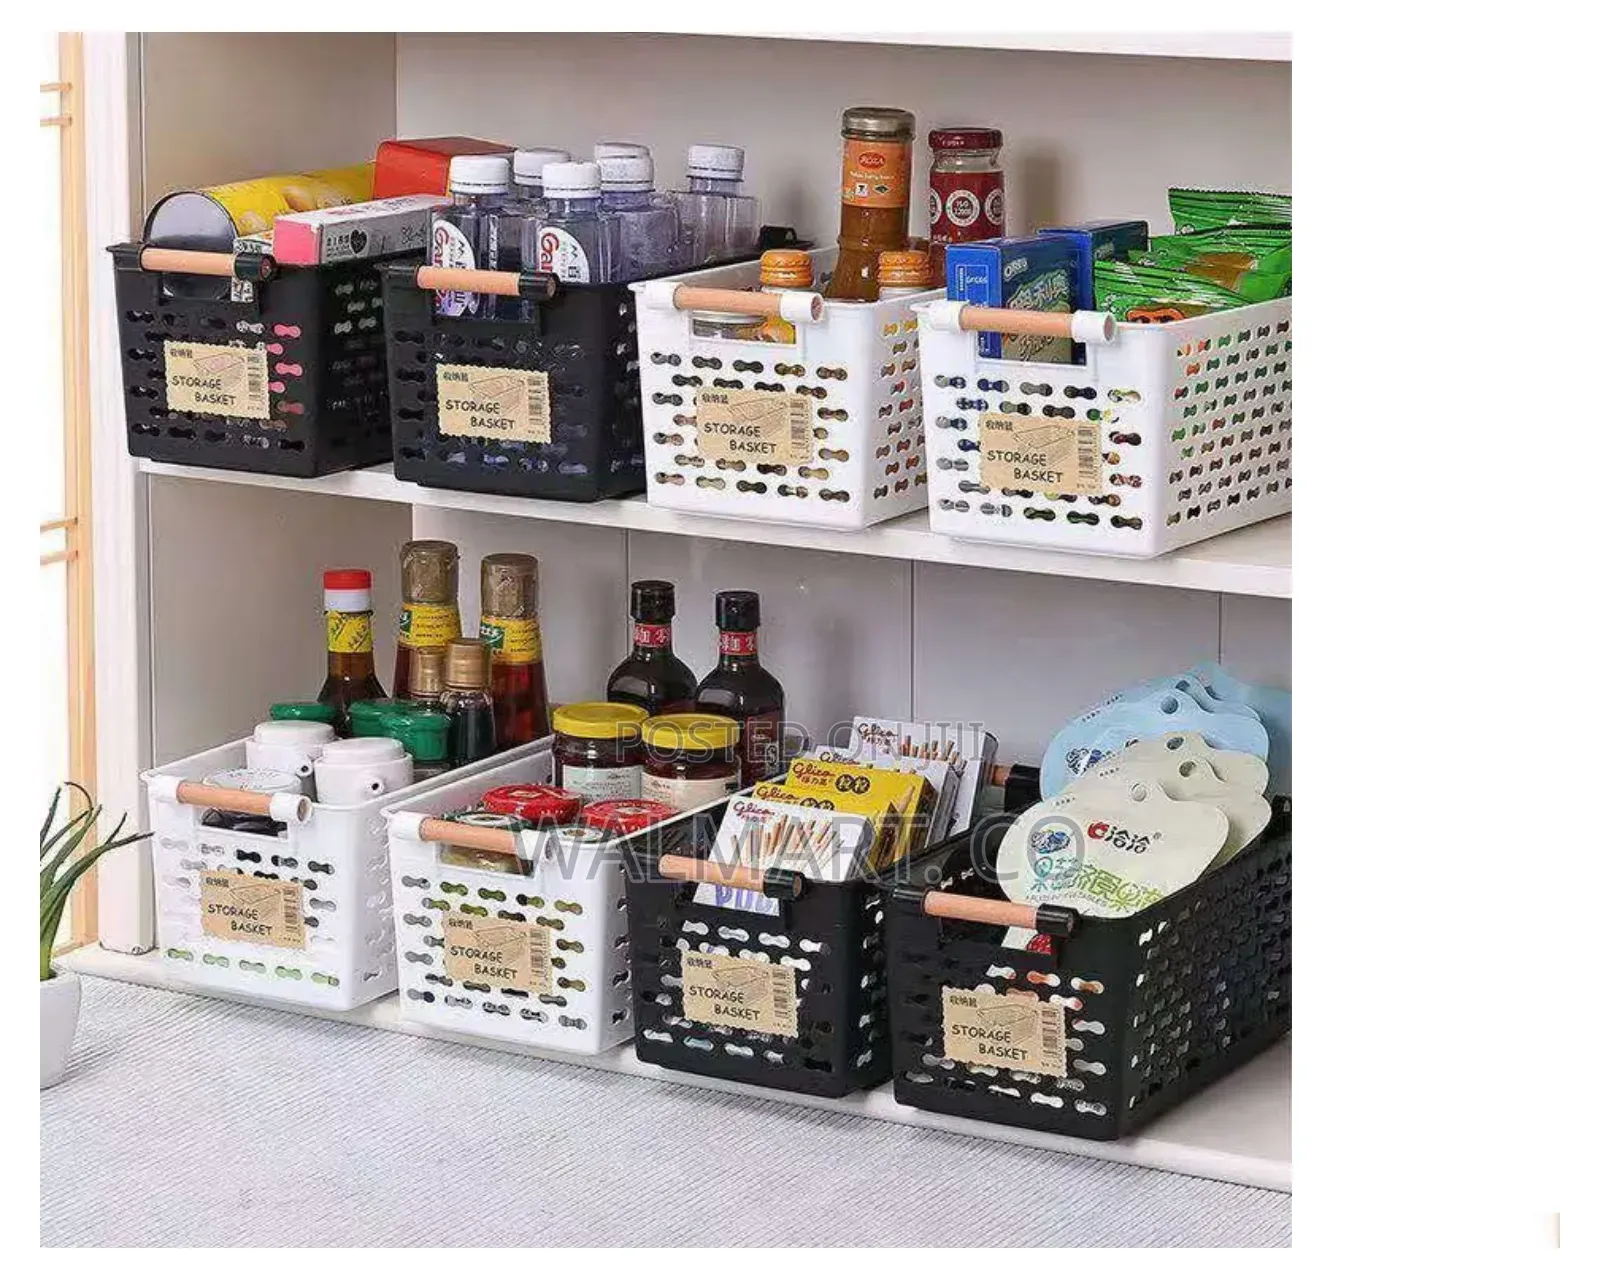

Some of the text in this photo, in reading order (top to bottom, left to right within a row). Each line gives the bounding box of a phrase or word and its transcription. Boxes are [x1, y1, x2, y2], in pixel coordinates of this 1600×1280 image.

[171, 376, 222, 390] STORAGE
[194, 391, 236, 405] BASKET
[445, 400, 500, 415] STORAGE
[470, 416, 515, 430] BASKET
[704, 423, 761, 438] STORAGE
[729, 440, 777, 454] BASKET
[987, 450, 1047, 467] STORAGE
[1013, 467, 1064, 484] BASKET
[793, 762, 836, 779] Glico
[756, 786, 800, 800] Glico
[733, 801, 775, 816] Glico
[208, 903, 259, 920] STORAGE
[231, 921, 272, 935] BASKET
[451, 946, 502, 963] STORAGE
[474, 963, 518, 979] BASKET
[689, 986, 744, 1004] STORAGE
[714, 1004, 761, 1020] BASKET
[952, 1025, 1012, 1043] STORAGE
[979, 1043, 1028, 1061] BASKET
